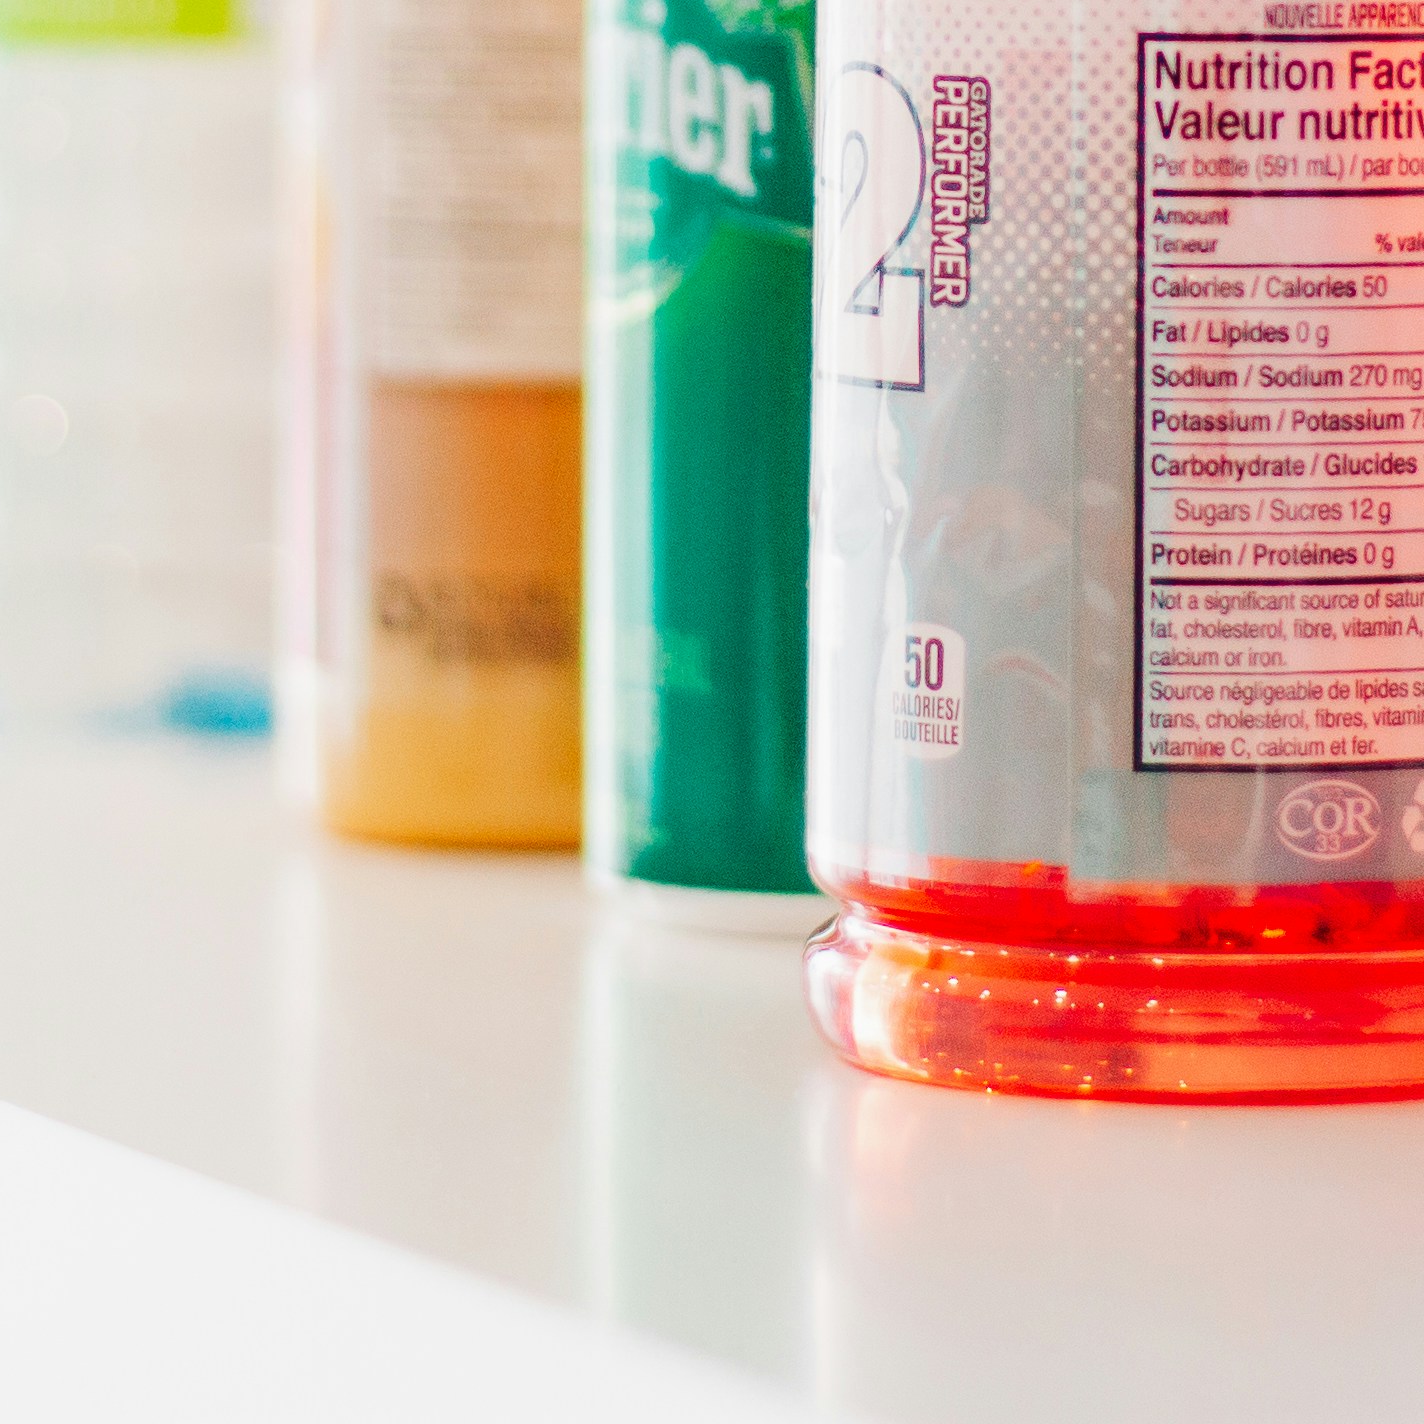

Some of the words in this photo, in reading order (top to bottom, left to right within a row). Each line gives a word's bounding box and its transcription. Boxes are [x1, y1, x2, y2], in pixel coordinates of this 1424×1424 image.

[1263, 3, 1343, 29] NOUVELLE
[1154, 50, 1334, 91] Nutrition
[1154, 101, 1285, 141] Valeur
[970, 81, 987, 219] GATORADE
[1153, 154, 1185, 177] Per
[1192, 154, 1250, 177] bottle
[1256, 153, 1299, 181] (591
[1306, 154, 1345, 181] mL)
[1361, 156, 1393, 182] par
[932, 79, 969, 303] PERFORMER
[1153, 205, 1230, 225] Amount
[1152, 233, 1218, 253] Teneur
[1375, 233, 1393, 253] %
[1152, 275, 1245, 298] Calories
[1265, 275, 1357, 298] Calories
[1362, 275, 1387, 298] 50
[1152, 320, 1187, 343] Fat
[1206, 320, 1290, 347] Lipides
[1295, 320, 1309, 343] 0
[1315, 325, 1330, 348] g
[1152, 364, 1238, 388] Sodium
[1259, 364, 1343, 388] Sodium
[1349, 364, 1387, 387] 270
[1393, 367, 1423, 390] mg
[1152, 409, 1270, 433] Potassium
[1292, 408, 1404, 432] Potassium
[1151, 454, 1305, 481] Carbohydrate
[1325, 453, 1418, 476] Glucides
[1175, 498, 1251, 526] Sugars
[1270, 498, 1342, 521] Sucres
[1349, 499, 1373, 520] 12
[1378, 501, 1391, 525] g
[1151, 543, 1232, 566] Protein
[1253, 541, 1357, 566] Protéines
[1363, 542, 1376, 565] 0
[1381, 545, 1395, 569] g
[1150, 591, 1182, 610] Not
[1188, 594, 1199, 610] a
[1204, 590, 1296, 614] significant
[1300, 593, 1359, 610] source
[1363, 589, 1381, 609] of
[1150, 619, 1178, 640] fat,
[1183, 618, 1287, 640] cholesterol,
[1293, 618, 1338, 640] fibre,
[1343, 616, 1403, 638] vitamin
[1405, 616, 1424, 638] A,
[904, 634, 945, 691] 50
[1149, 646, 1219, 667] calcium
[1225, 650, 1241, 667] or
[1248, 647, 1287, 667] iron.
[1150, 681, 1214, 702] Source
[1220, 679, 1324, 705] négligeable
[1328, 678, 1350, 700] de
[1355, 676, 1409, 704] lipides
[892, 691, 961, 722] CALORIES/
[1150, 710, 1200, 730] trans,
[1205, 708, 1309, 730] cholestérol,
[1315, 707, 1367, 729] fibres,
[894, 719, 960, 746] BOUTEILLE
[1149, 736, 1225, 757] vitamine
[1231, 736, 1252, 760] C,
[1256, 735, 1325, 757] calcium
[1330, 738, 1347, 756] et
[1351, 734, 1379, 756] fer.
